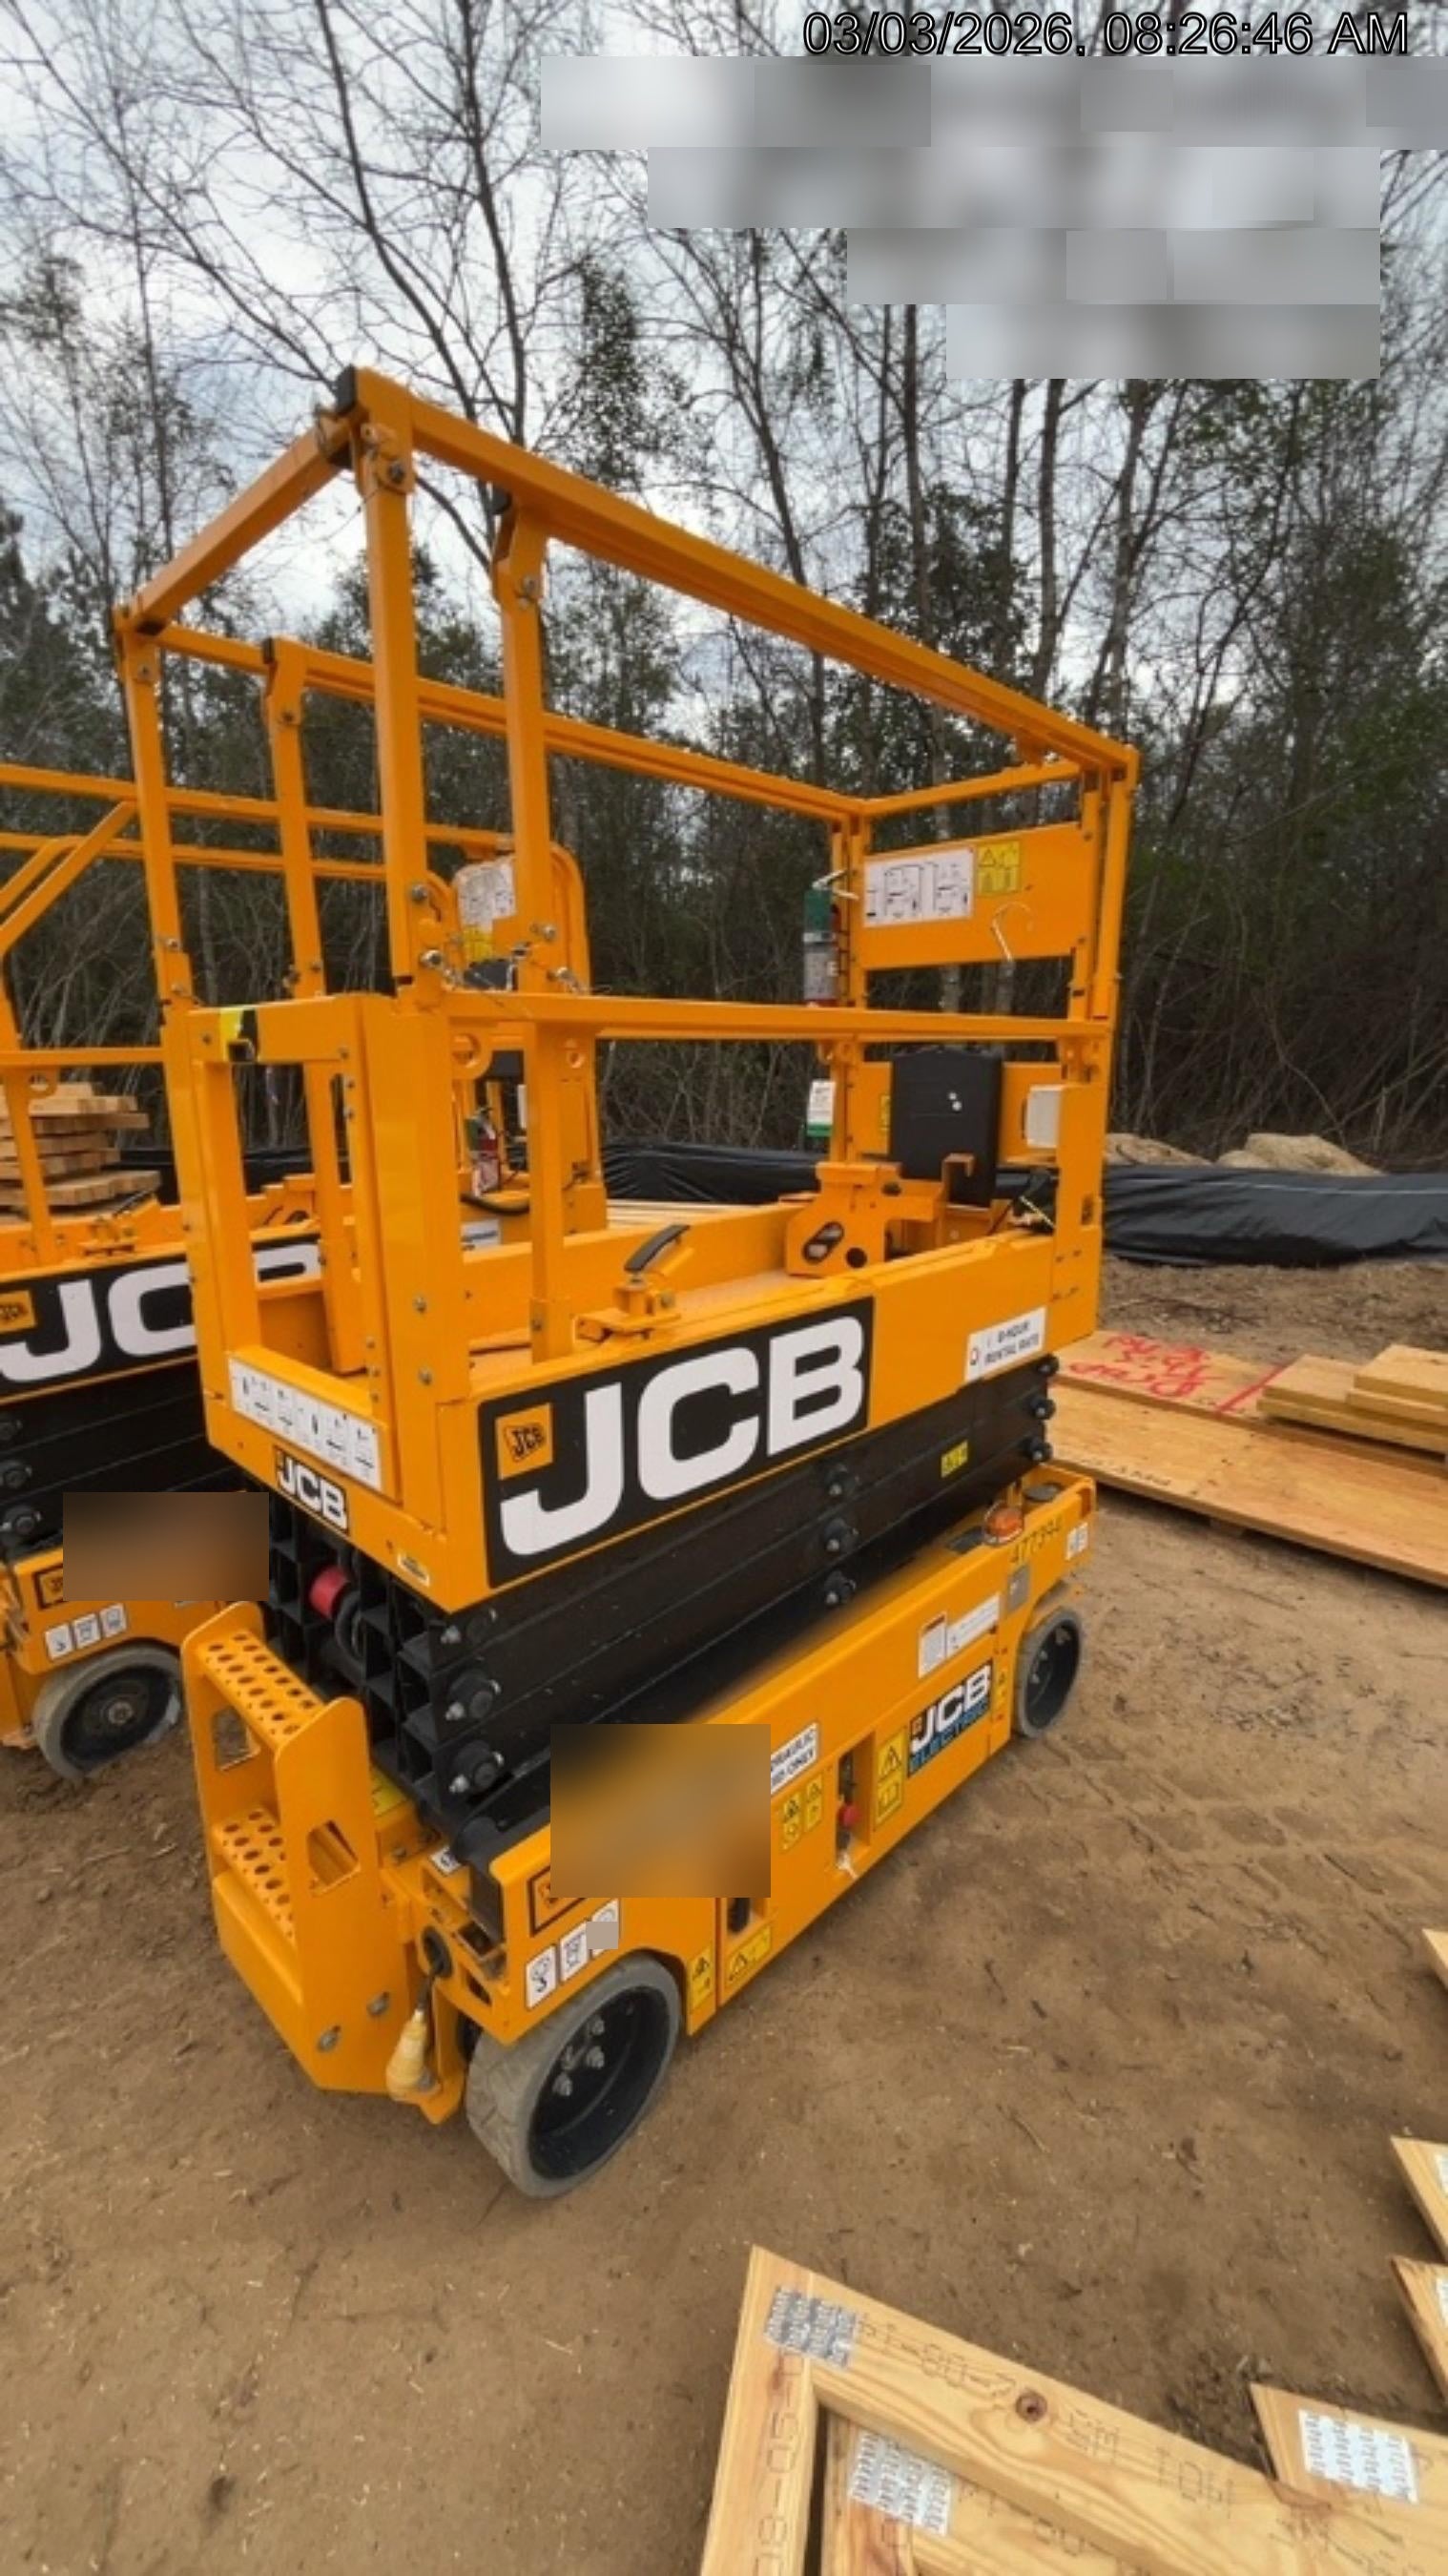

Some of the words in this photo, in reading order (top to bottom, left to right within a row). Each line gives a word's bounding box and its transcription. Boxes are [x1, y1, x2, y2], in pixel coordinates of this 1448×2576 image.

[500, 1315, 864, 1556] JCB
[511, 1426, 545, 1457] JCB
[278, 1455, 348, 1529] JCB
[911, 1664, 992, 1754] JCB
